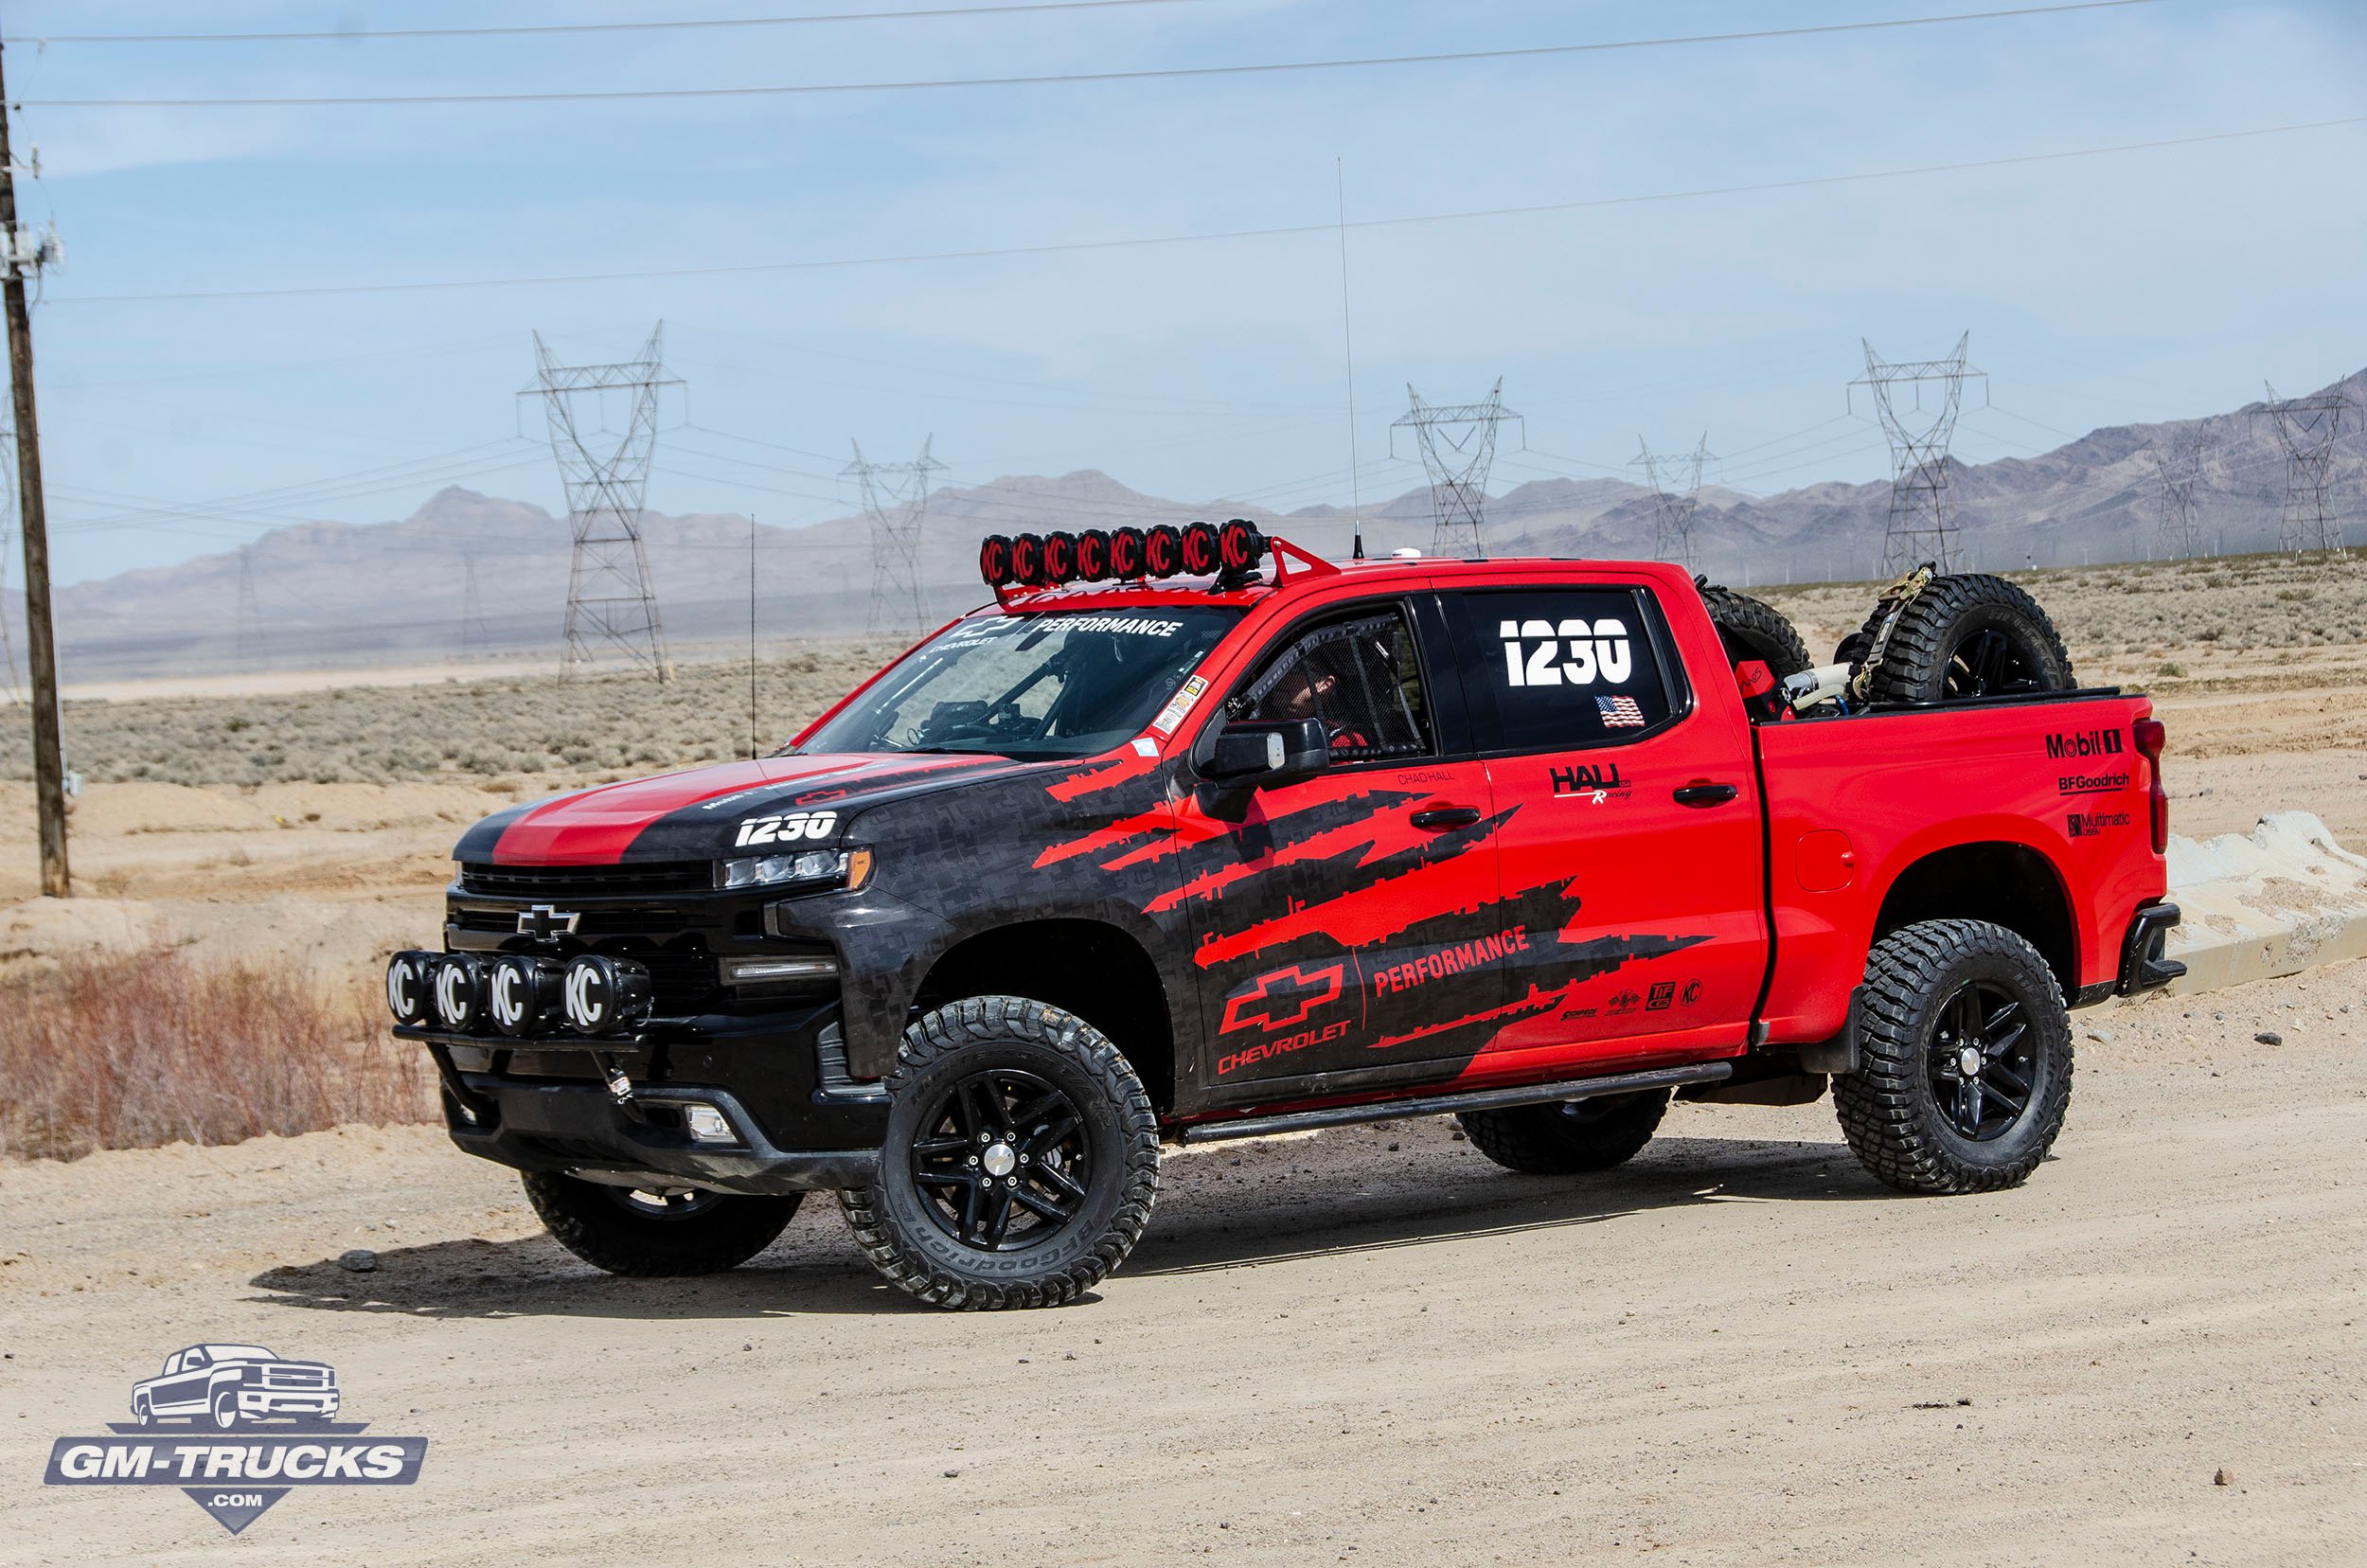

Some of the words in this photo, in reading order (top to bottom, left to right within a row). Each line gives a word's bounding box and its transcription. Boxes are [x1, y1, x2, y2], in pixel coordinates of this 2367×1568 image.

[983, 541, 1003, 579] KC
[1012, 539, 1033, 579] KC
[1044, 537, 1067, 579] KC
[1077, 535, 1100, 577] KC
[1110, 532, 1134, 575] KC
[1146, 530, 1171, 572] KC
[1184, 527, 1209, 571] KC
[1220, 525, 1247, 568] KC
[1032, 617, 1184, 637] PERFORMANCE
[1500, 619, 1631, 686] 1230
[2046, 730, 2101, 758] Mobil
[1397, 774, 1428, 785] CHAD
[1428, 771, 1454, 782] HALL
[1549, 763, 1620, 793] HALL
[2058, 773, 2129, 791] BFGoodrich
[735, 811, 838, 847] 1230
[2081, 811, 2130, 828] Multimatic
[1374, 925, 1529, 997] PERFORMANCE
[388, 959, 415, 1018] KC
[436, 964, 466, 1024] KC
[491, 964, 523, 1025] KC
[565, 964, 601, 1025] KC
[1683, 982, 1700, 1004] KC
[1218, 1019, 1351, 1076] CHEVROLET
